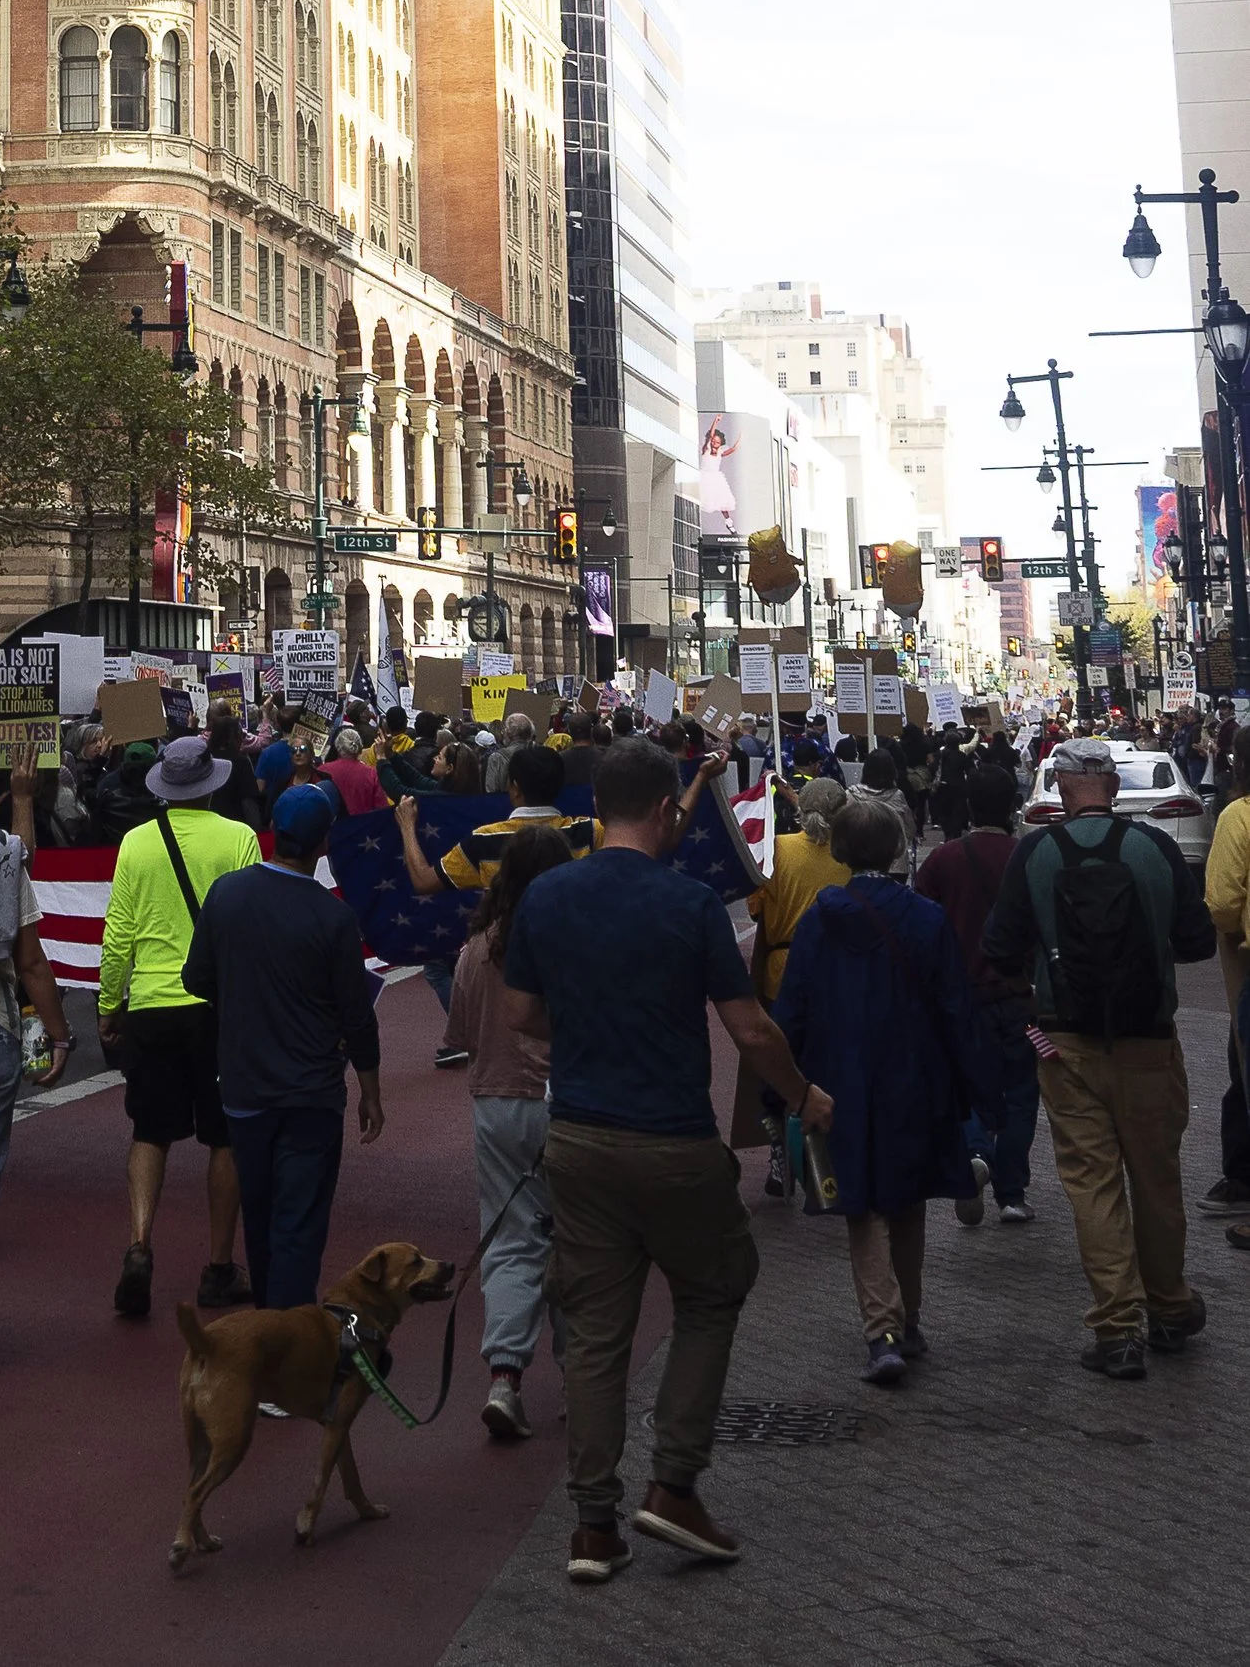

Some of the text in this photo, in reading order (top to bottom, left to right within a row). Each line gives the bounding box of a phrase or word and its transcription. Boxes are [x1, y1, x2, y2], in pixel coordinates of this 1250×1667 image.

[342, 537, 389, 547] 12th St
[939, 549, 956, 557] ONE
[939, 557, 957, 565] WAY
[1027, 566, 1069, 575] 12th St
[295, 633, 326, 643] PHILLY
[287, 644, 314, 652] BELONGS
[11, 648, 24, 667] IS
[28, 648, 55, 666] NOT
[287, 651, 336, 663] WORKERS
[21, 667, 54, 685] SALE
[289, 670, 334, 682] NOT THE
[471, 678, 489, 687] NO
[1167, 680, 1194, 689] SHOW US
[0, 686, 44, 700] STOP THE
[483, 689, 506, 699] KIN
[306, 691, 317, 703] PA
[316, 694, 323, 705] IS
[323, 698, 338, 712] NOT
[304, 700, 335, 721] FOR SALE
[24, 722, 56, 741] YES!
[37, 742, 56, 754] OUR
